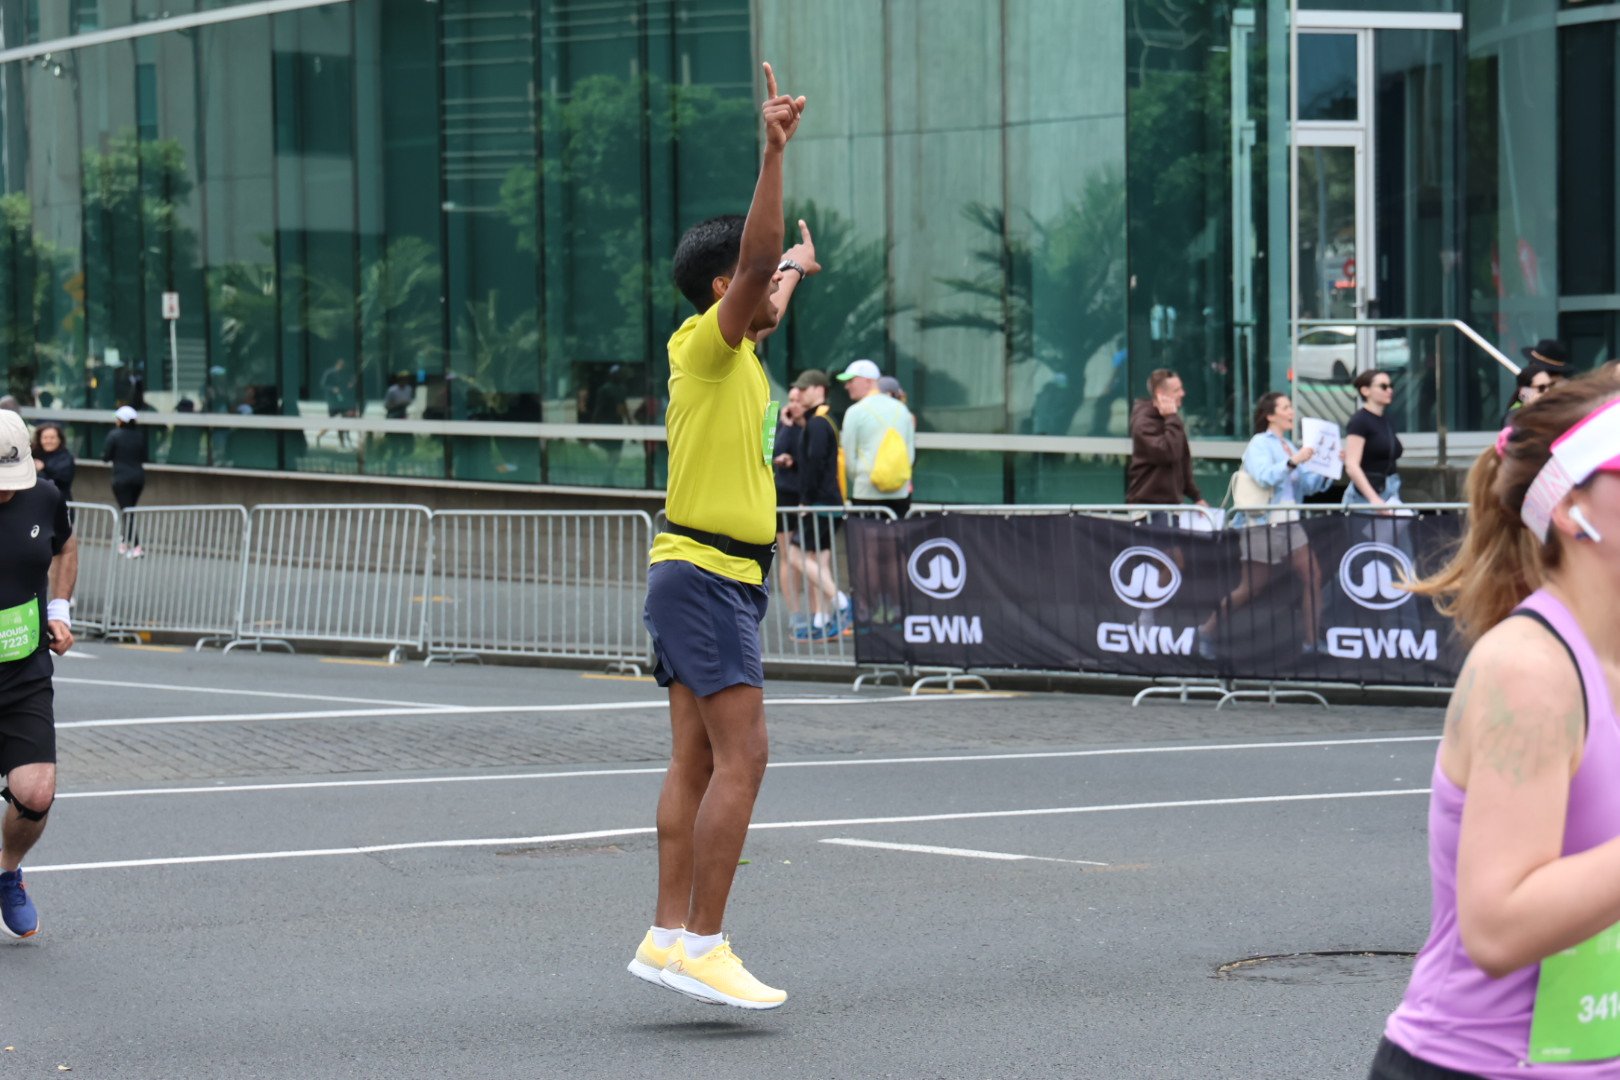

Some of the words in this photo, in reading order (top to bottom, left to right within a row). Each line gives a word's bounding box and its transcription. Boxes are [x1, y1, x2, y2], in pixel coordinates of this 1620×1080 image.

[1, 634, 29, 650] 7223
[903, 614, 983, 644] GWM
[1097, 621, 1195, 656] GWM
[1326, 626, 1438, 661] GWM
[1577, 991, 1620, 1023] 341
